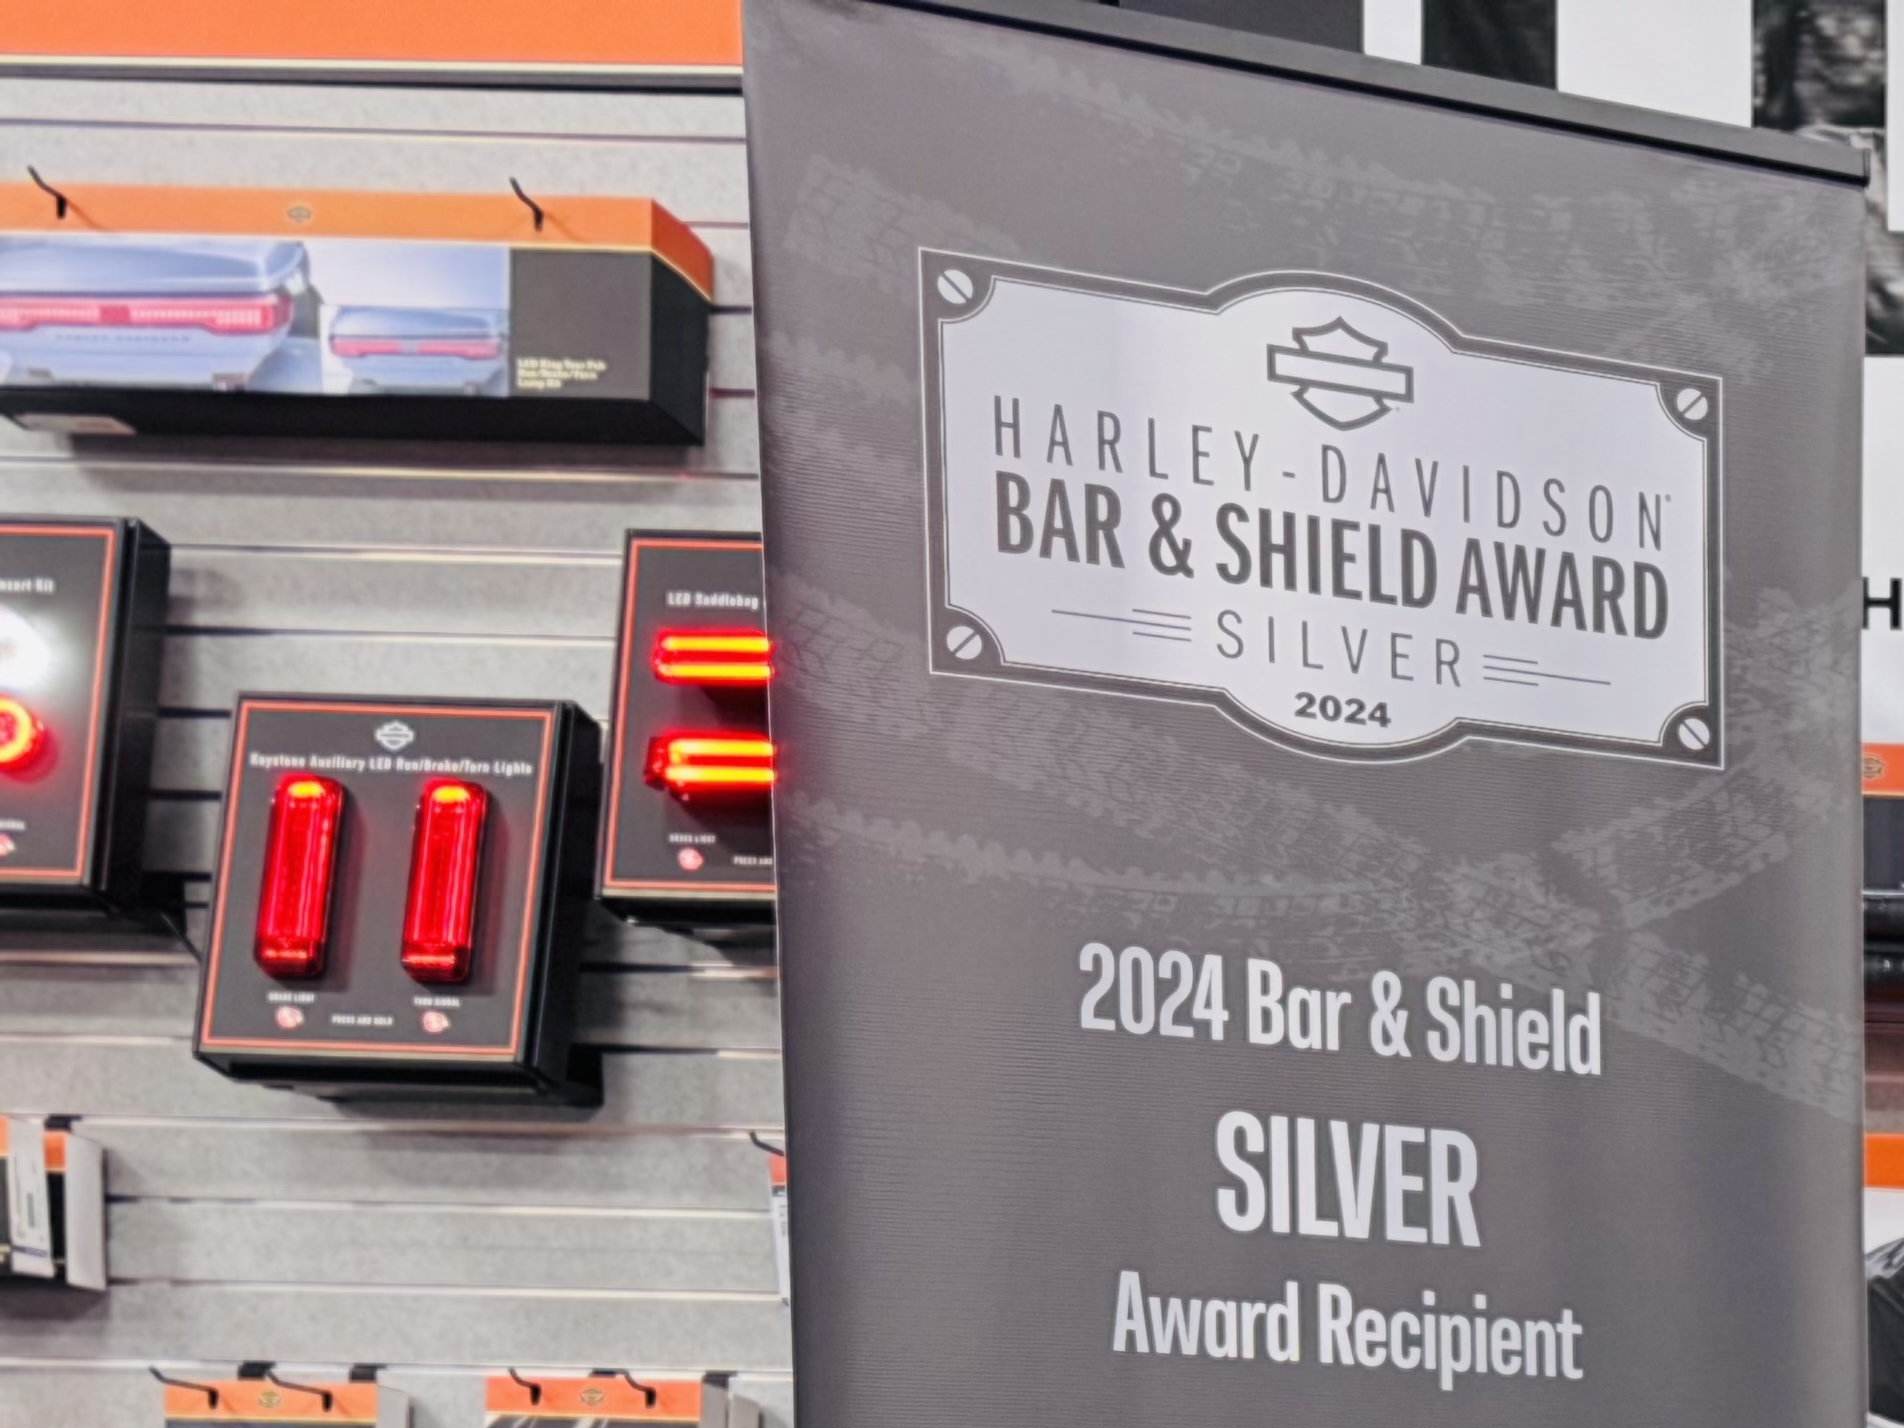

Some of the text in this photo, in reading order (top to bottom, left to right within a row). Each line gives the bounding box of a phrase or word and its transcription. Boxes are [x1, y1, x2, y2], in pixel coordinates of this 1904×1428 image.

[994, 396, 1664, 551] HARLEY-DAVIDSON
[996, 470, 1669, 641] BAR & SHIELD AWARD
[1216, 609, 1462, 688] SILVER
[1293, 691, 1393, 728] 2024
[309, 755, 366, 772] Auxiliary
[369, 756, 391, 770] LED
[494, 760, 534, 778] Lights
[1079, 942, 1602, 1076] 2024 Bar & Shield
[1216, 1110, 1481, 1248] SILVER
[1112, 1270, 1585, 1392] Award Recipient
